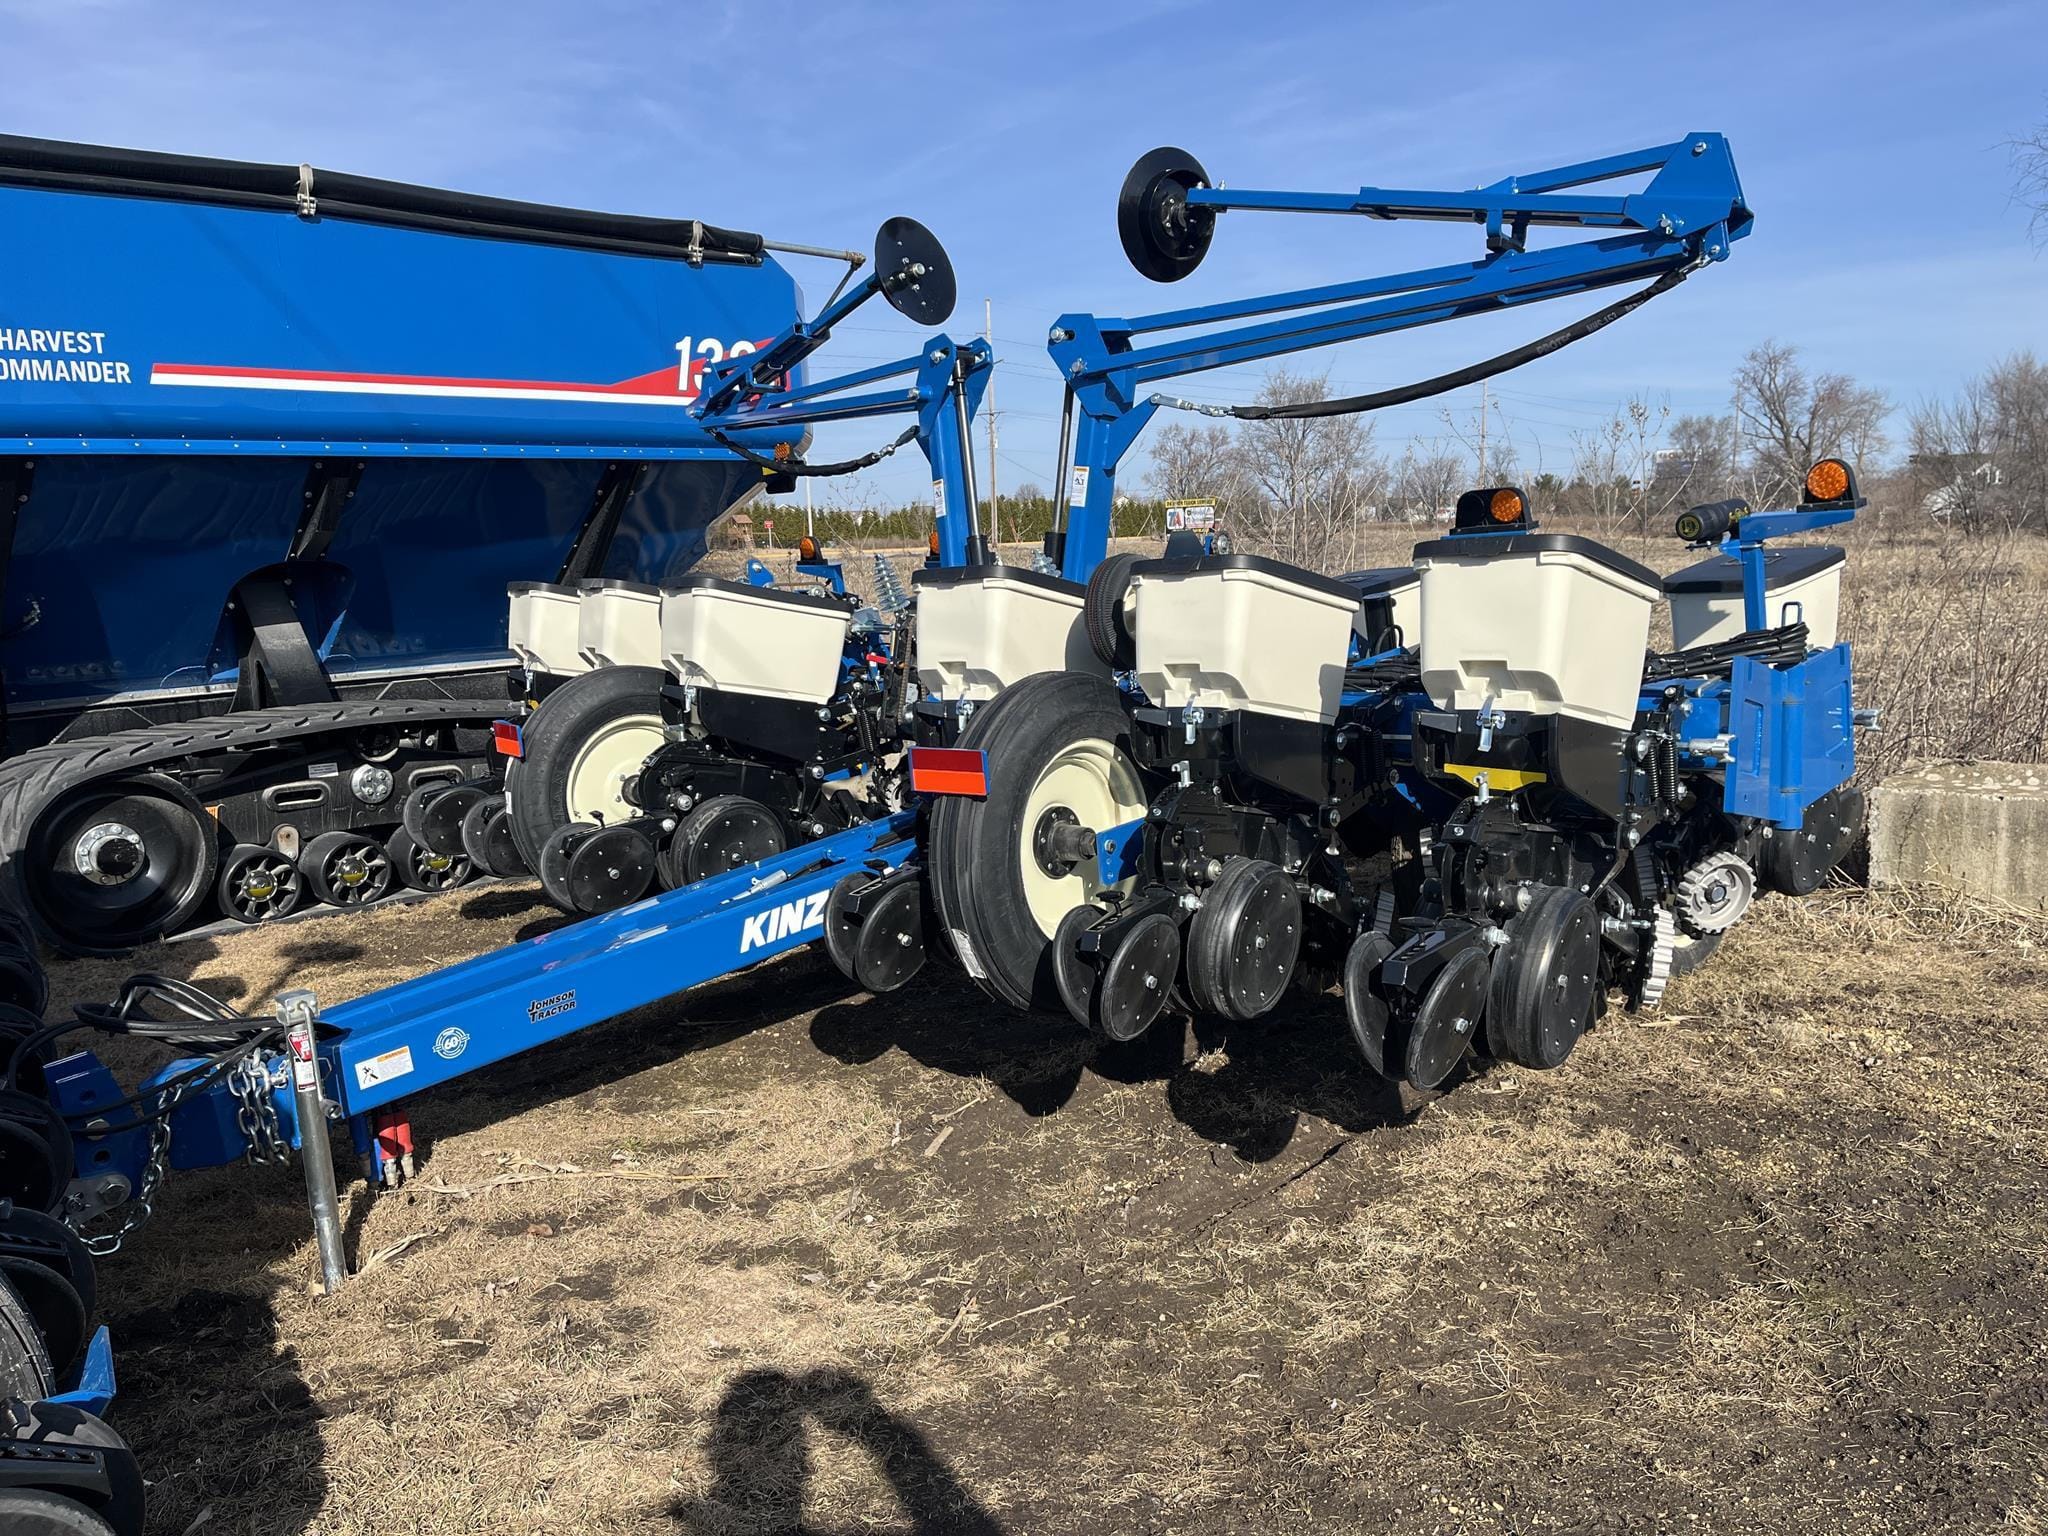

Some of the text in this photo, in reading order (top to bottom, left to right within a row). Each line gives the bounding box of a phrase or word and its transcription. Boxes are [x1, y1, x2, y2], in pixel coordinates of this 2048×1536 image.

[0, 328, 105, 354] HARVEST
[740, 888, 833, 954] KINZ
[530, 1000, 577, 1024] TRACTOR
[444, 1036, 461, 1050] 60
